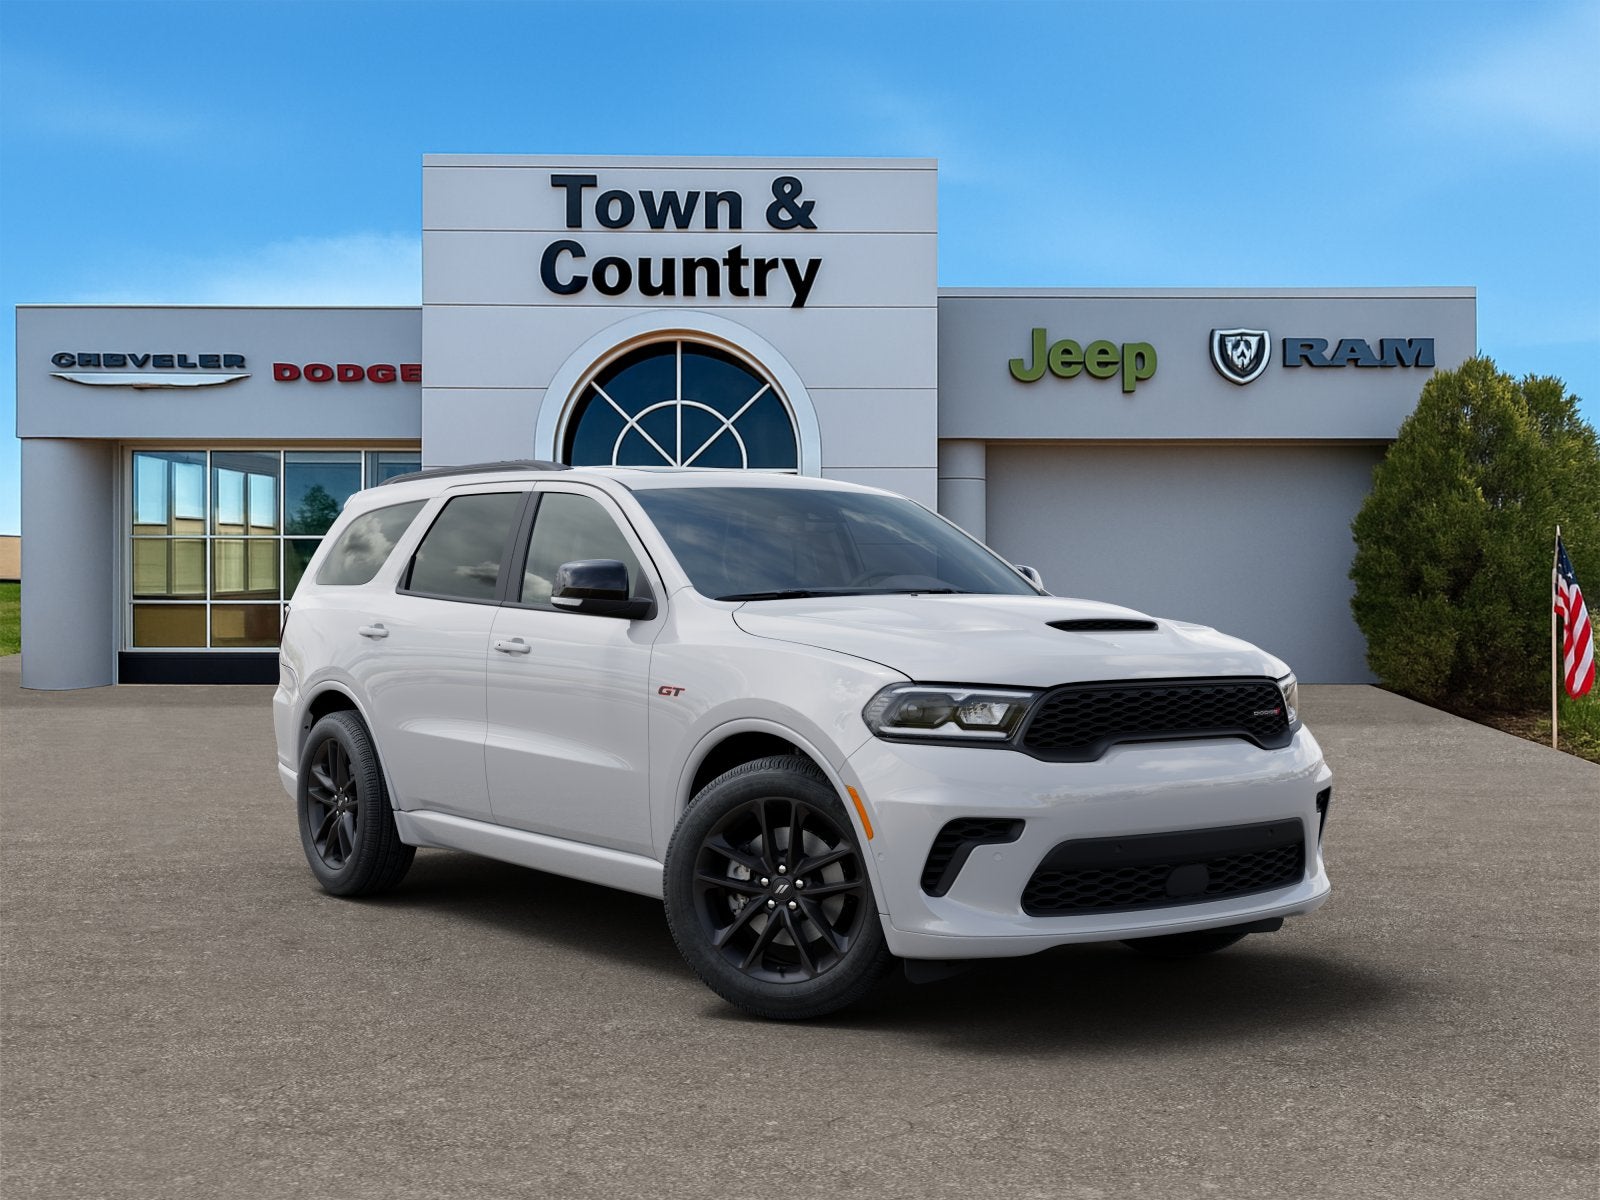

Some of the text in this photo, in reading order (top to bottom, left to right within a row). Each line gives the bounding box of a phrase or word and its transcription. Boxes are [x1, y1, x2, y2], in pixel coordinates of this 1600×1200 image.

[551, 174, 818, 230] Town &
[540, 239, 822, 308] Country
[273, 363, 422, 383] DODGE
[1009, 328, 1157, 393] Jeep
[1282, 337, 1435, 368] RAM
[658, 685, 686, 697] GT
